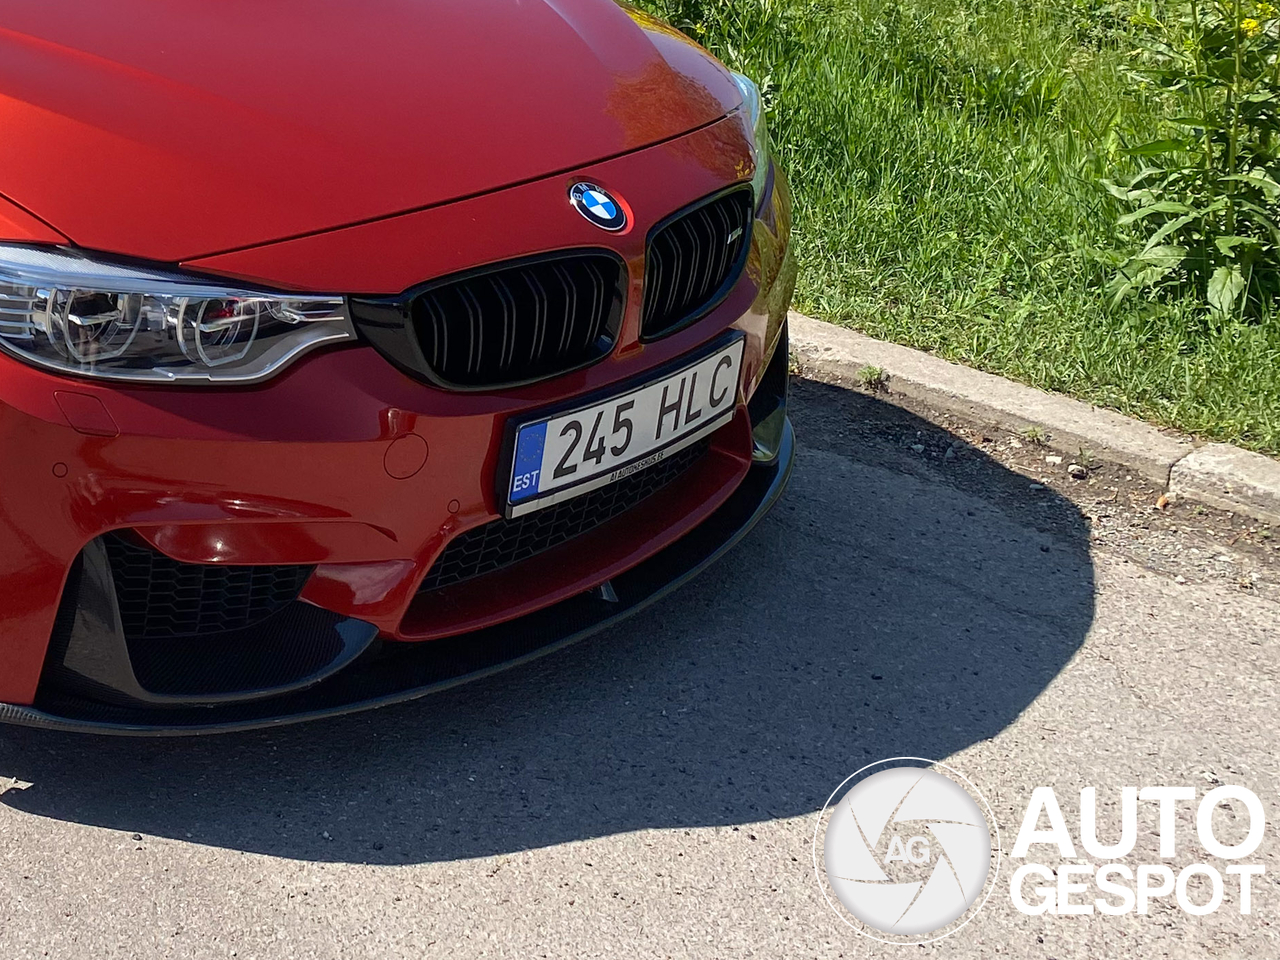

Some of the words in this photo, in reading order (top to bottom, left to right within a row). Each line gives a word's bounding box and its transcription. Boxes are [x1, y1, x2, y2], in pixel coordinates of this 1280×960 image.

[552, 399, 636, 481] 245
[654, 354, 733, 441] HLC
[512, 469, 540, 492] EST
